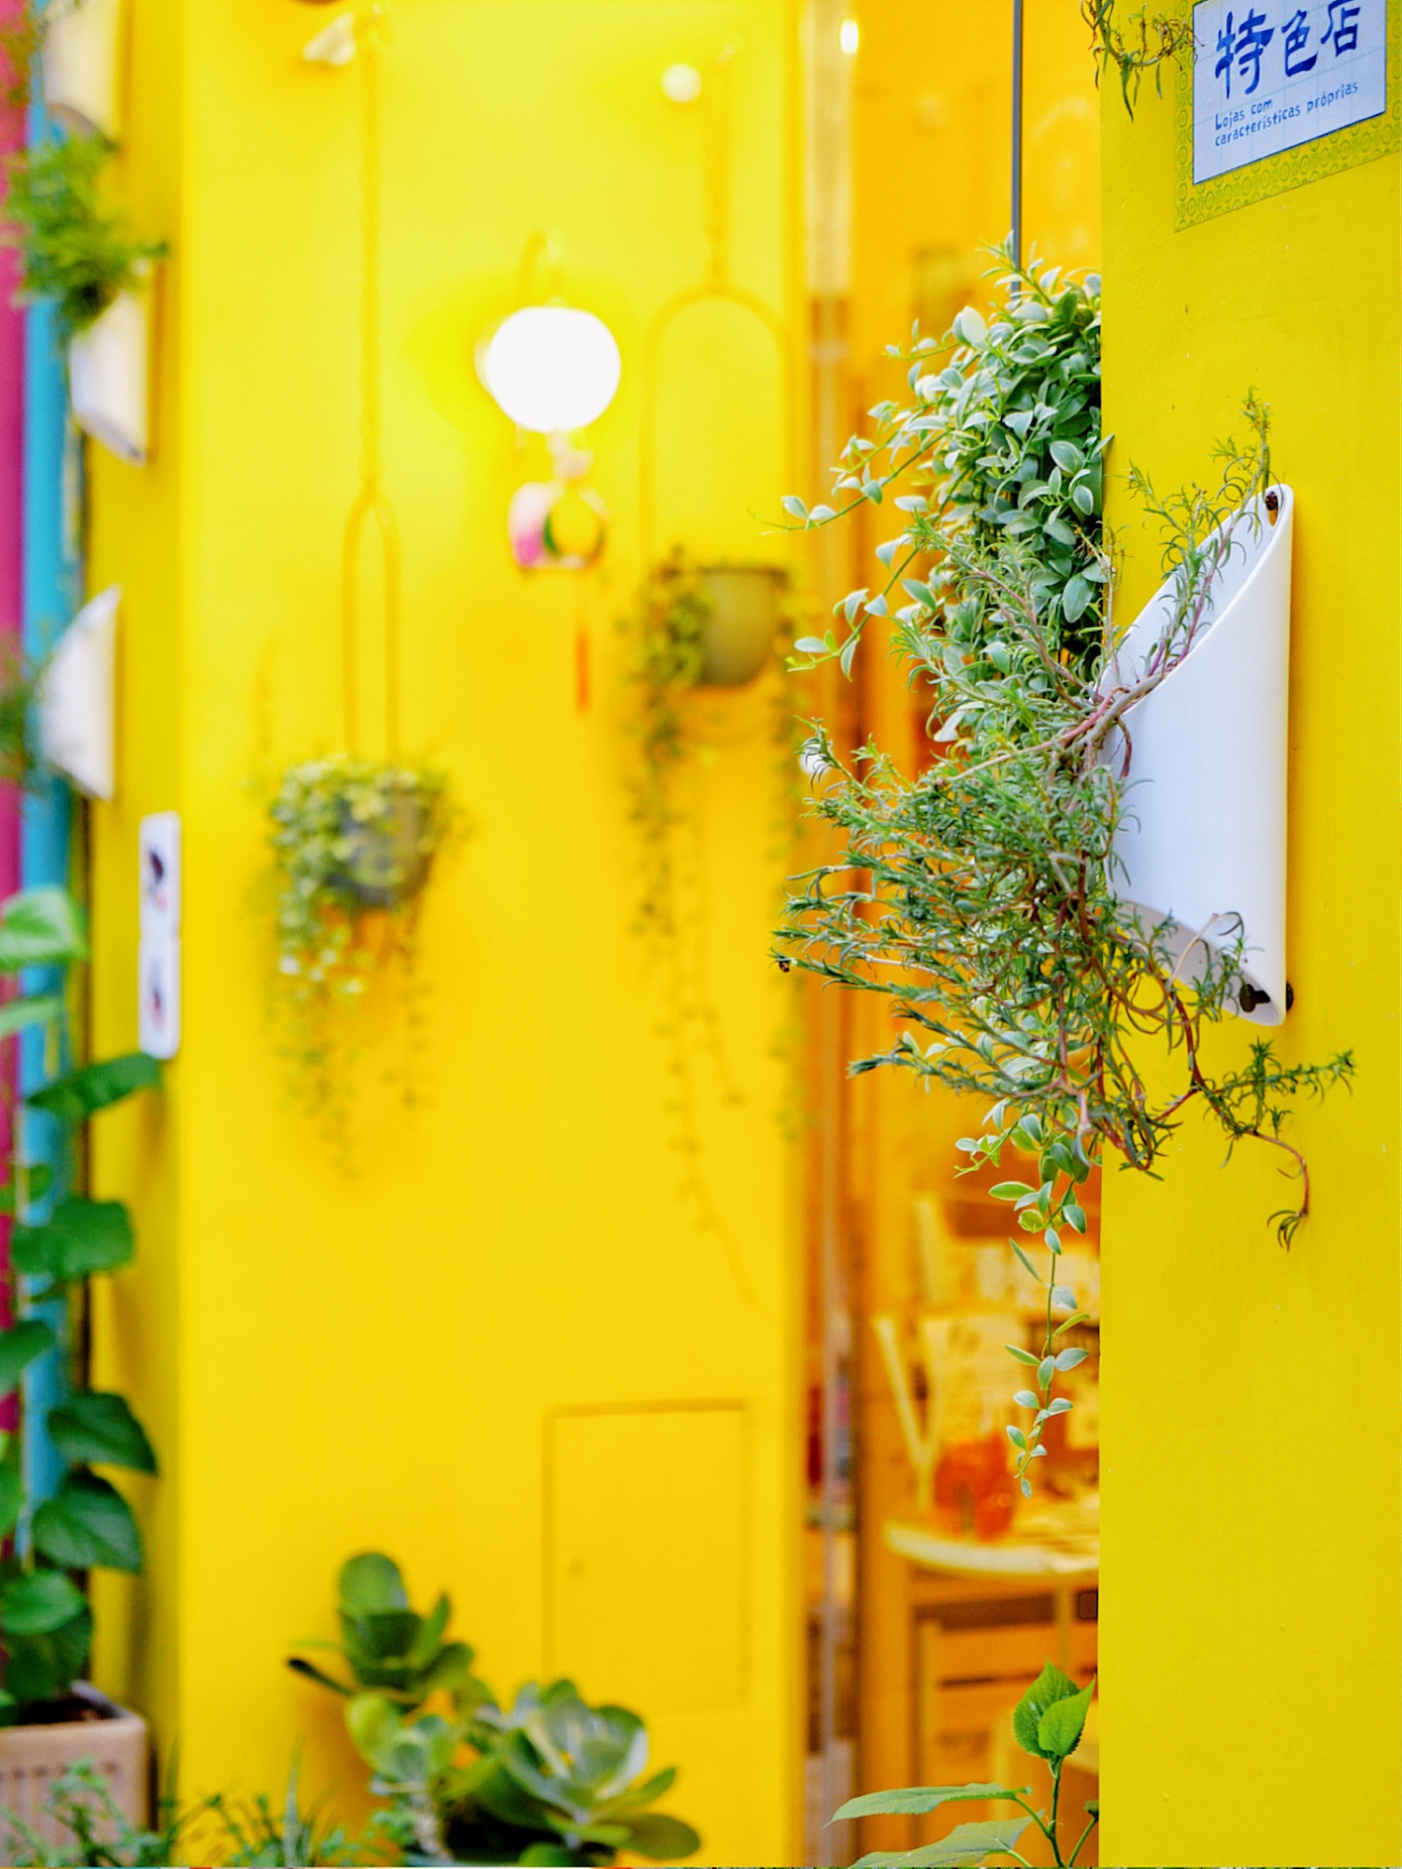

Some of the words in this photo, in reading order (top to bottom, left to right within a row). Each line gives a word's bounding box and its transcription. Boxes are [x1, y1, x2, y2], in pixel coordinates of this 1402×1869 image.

[1215, 0, 1361, 99] 特色店
[1215, 104, 1301, 147] características
[1306, 81, 1359, 114] próprias
[1215, 111, 1245, 131] Lojas
[1250, 98, 1273, 116] com
